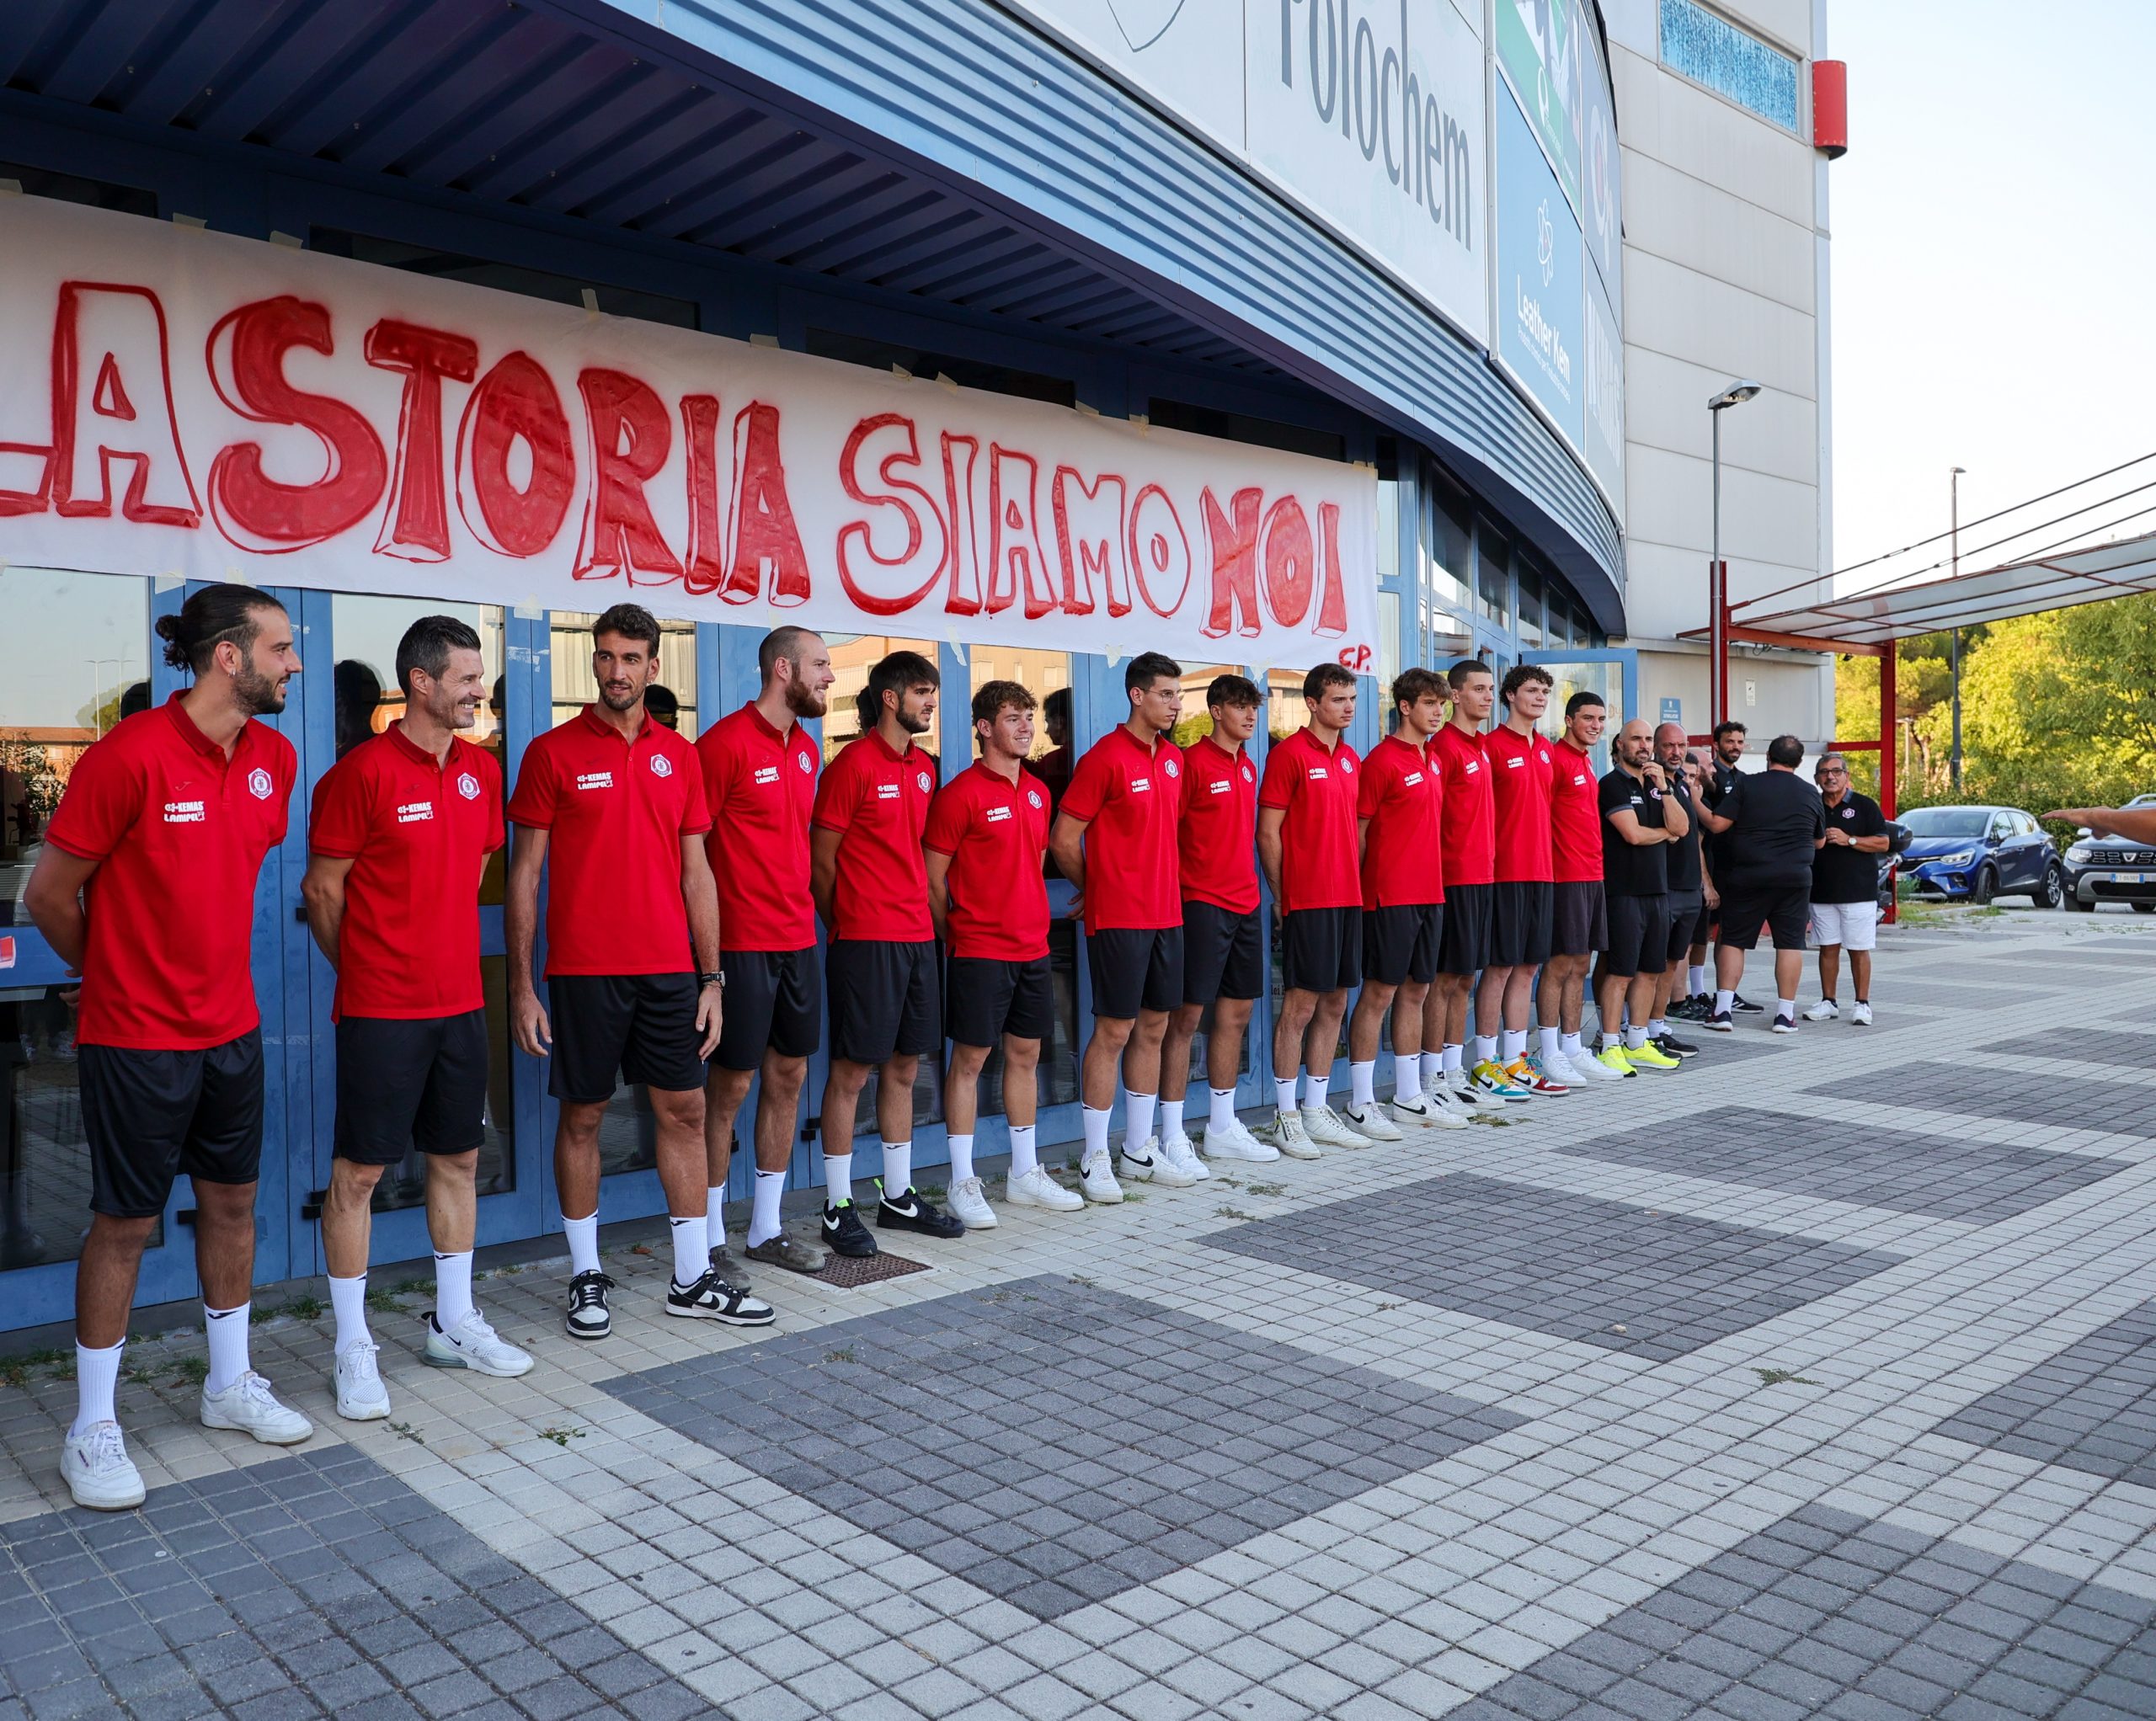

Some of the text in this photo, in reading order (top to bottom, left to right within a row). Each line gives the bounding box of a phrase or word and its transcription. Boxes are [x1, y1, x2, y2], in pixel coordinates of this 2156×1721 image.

[1517, 274, 1552, 357] Leather
[1553, 326, 1571, 385] Kem
[836, 413, 1192, 620] SIAMO
[1199, 485, 1348, 640] NOI
[178, 801, 204, 813] KEMAS
